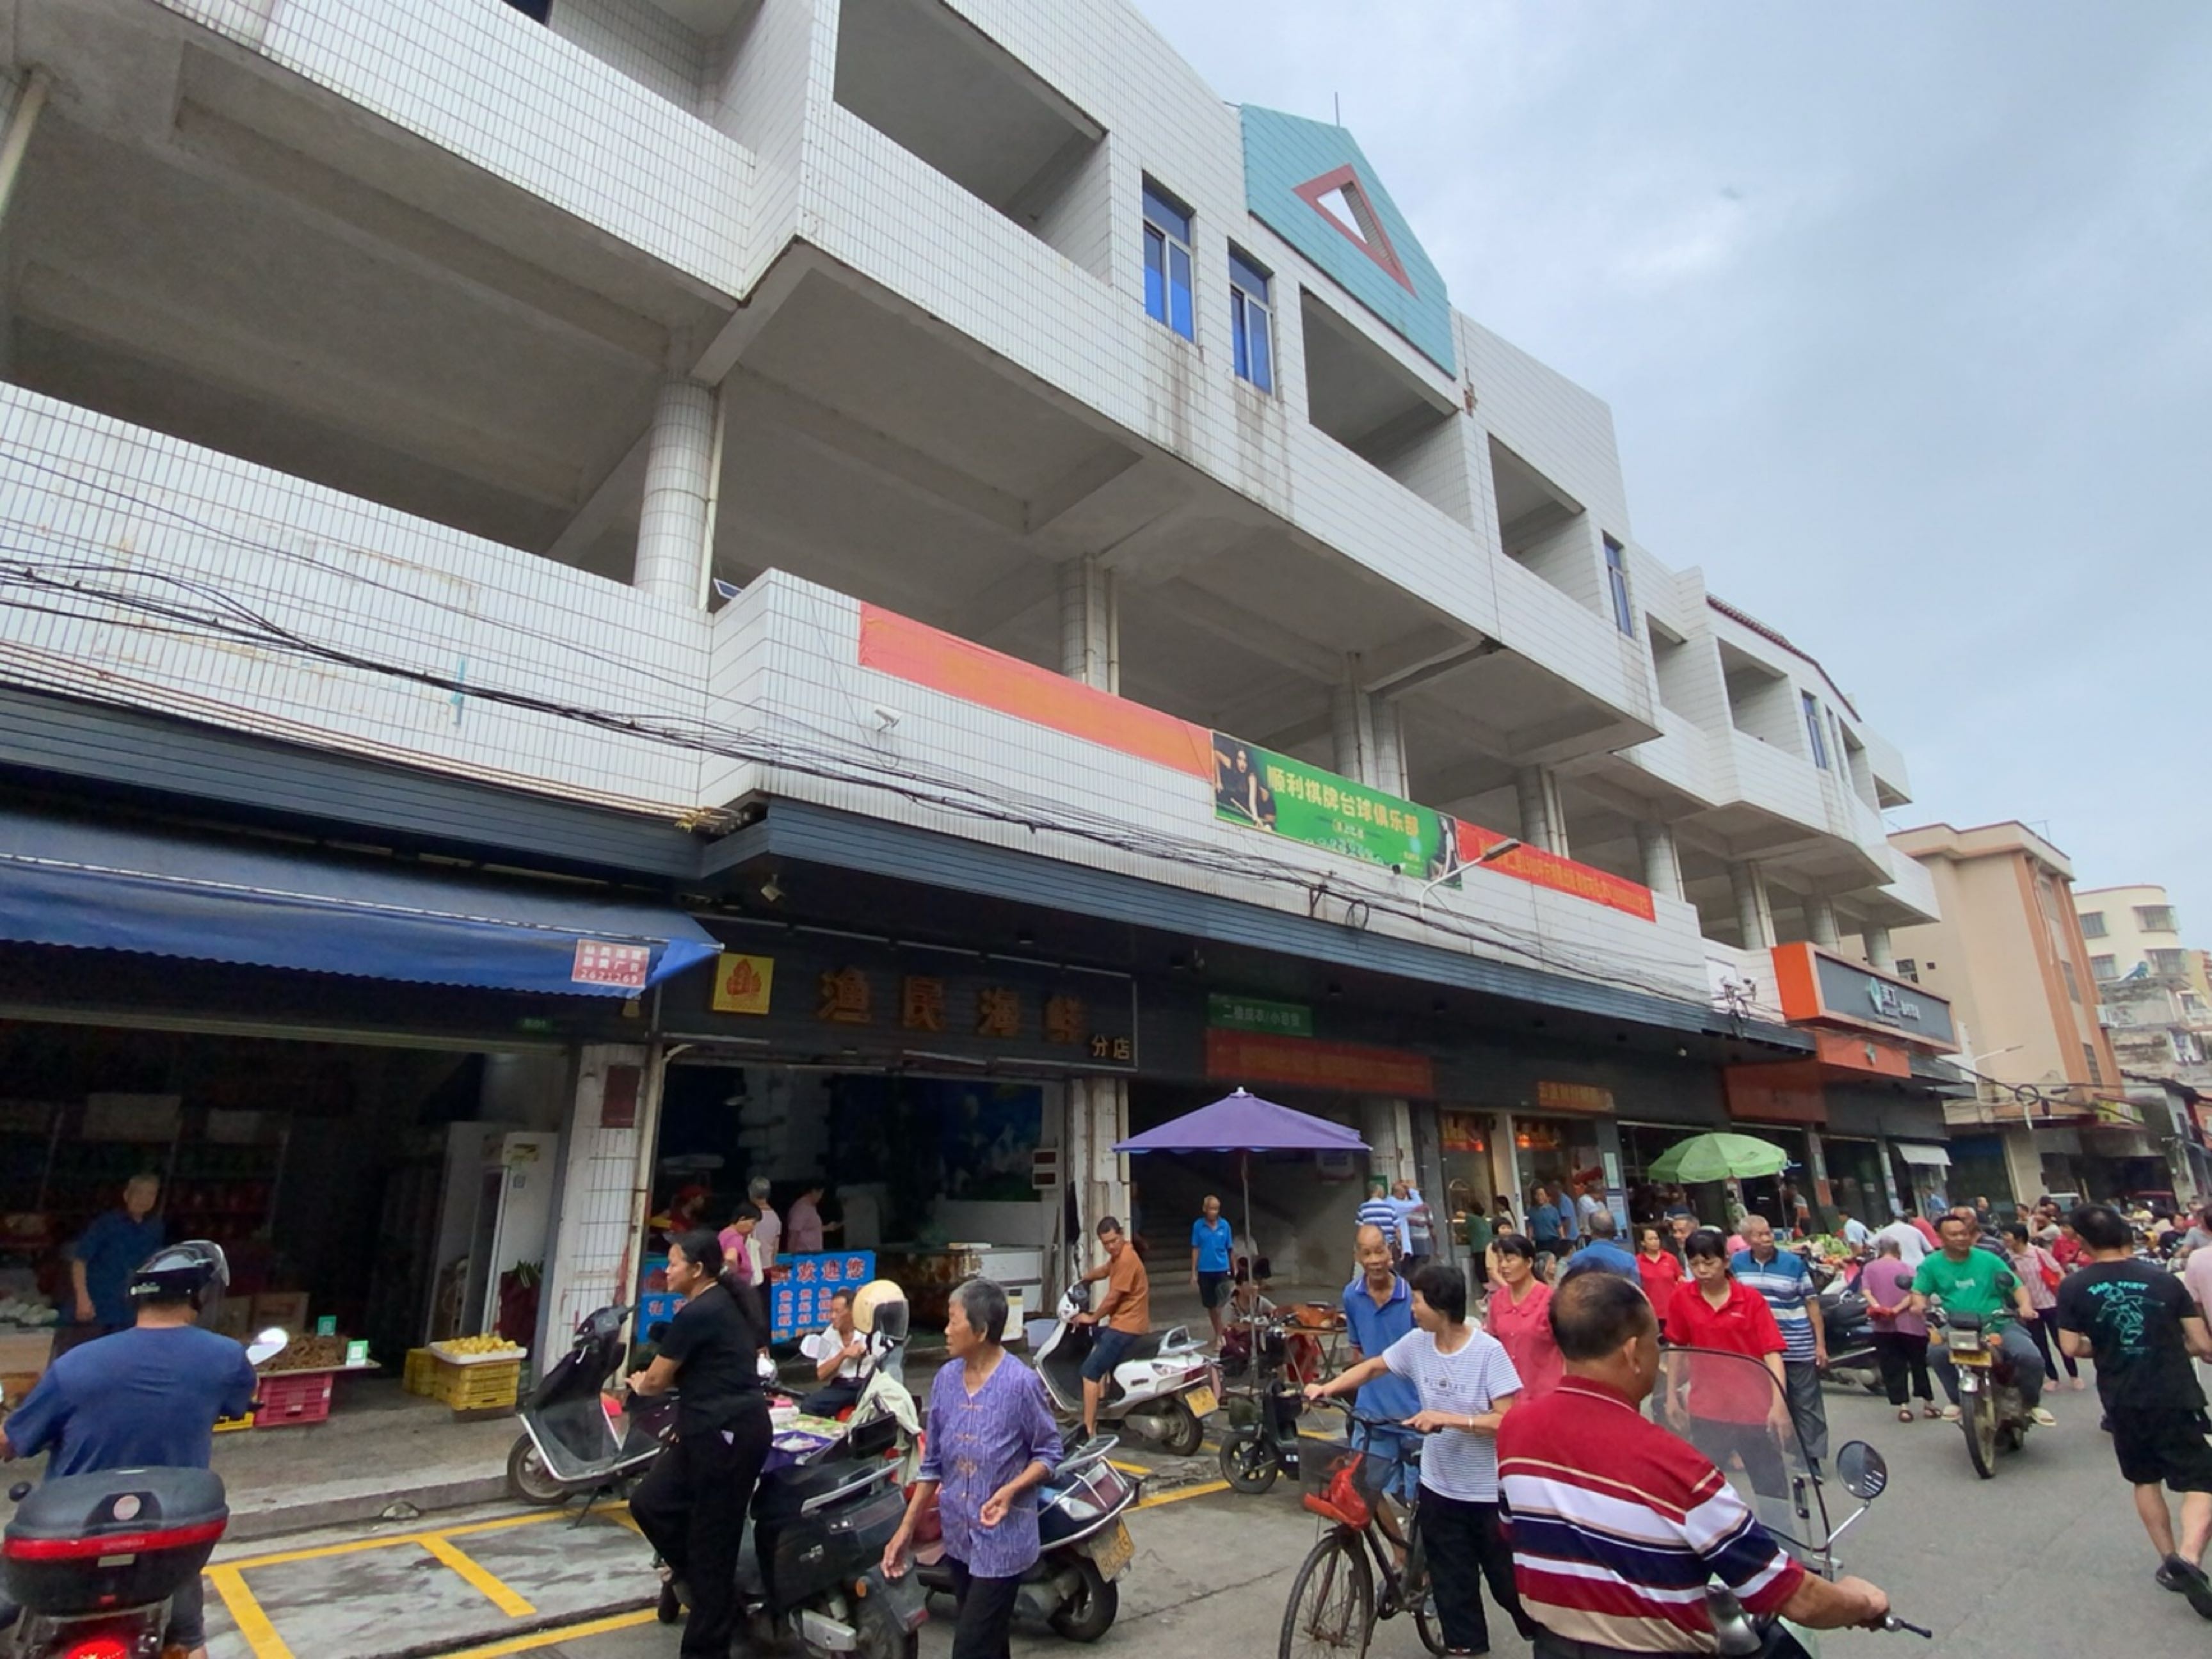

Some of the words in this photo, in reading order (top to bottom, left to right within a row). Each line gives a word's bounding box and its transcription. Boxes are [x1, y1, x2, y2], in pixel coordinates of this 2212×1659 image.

[1267, 765, 1420, 837] 顺利棋牌台球俱乐部
[1091, 1035, 1132, 1061] 分店
[796, 1257, 866, 1285] 欢迎您
